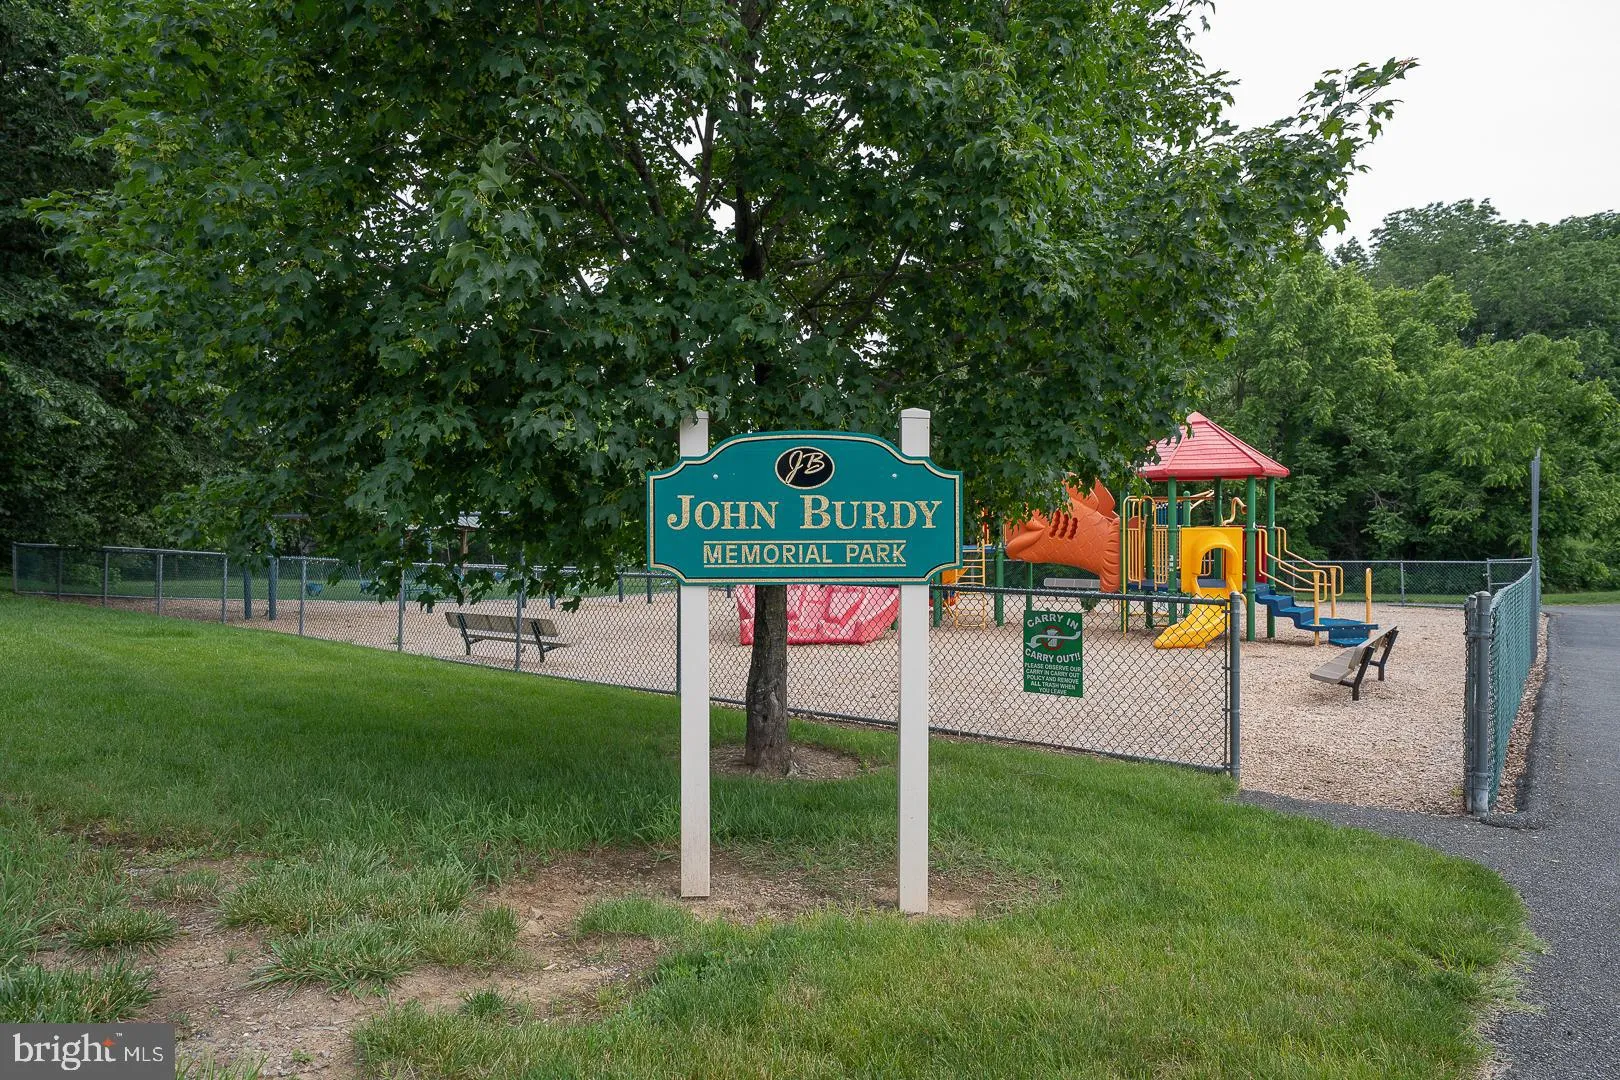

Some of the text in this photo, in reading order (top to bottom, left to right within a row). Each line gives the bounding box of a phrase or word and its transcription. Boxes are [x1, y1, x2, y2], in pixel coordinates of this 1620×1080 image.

[785, 449, 826, 486] JB
[667, 494, 942, 530] JOHN BURDY
[703, 543, 907, 564] MEMORIAL PARK
[1026, 613, 1079, 630] CARRY IN
[1025, 648, 1081, 663] CARRY OUT!!
